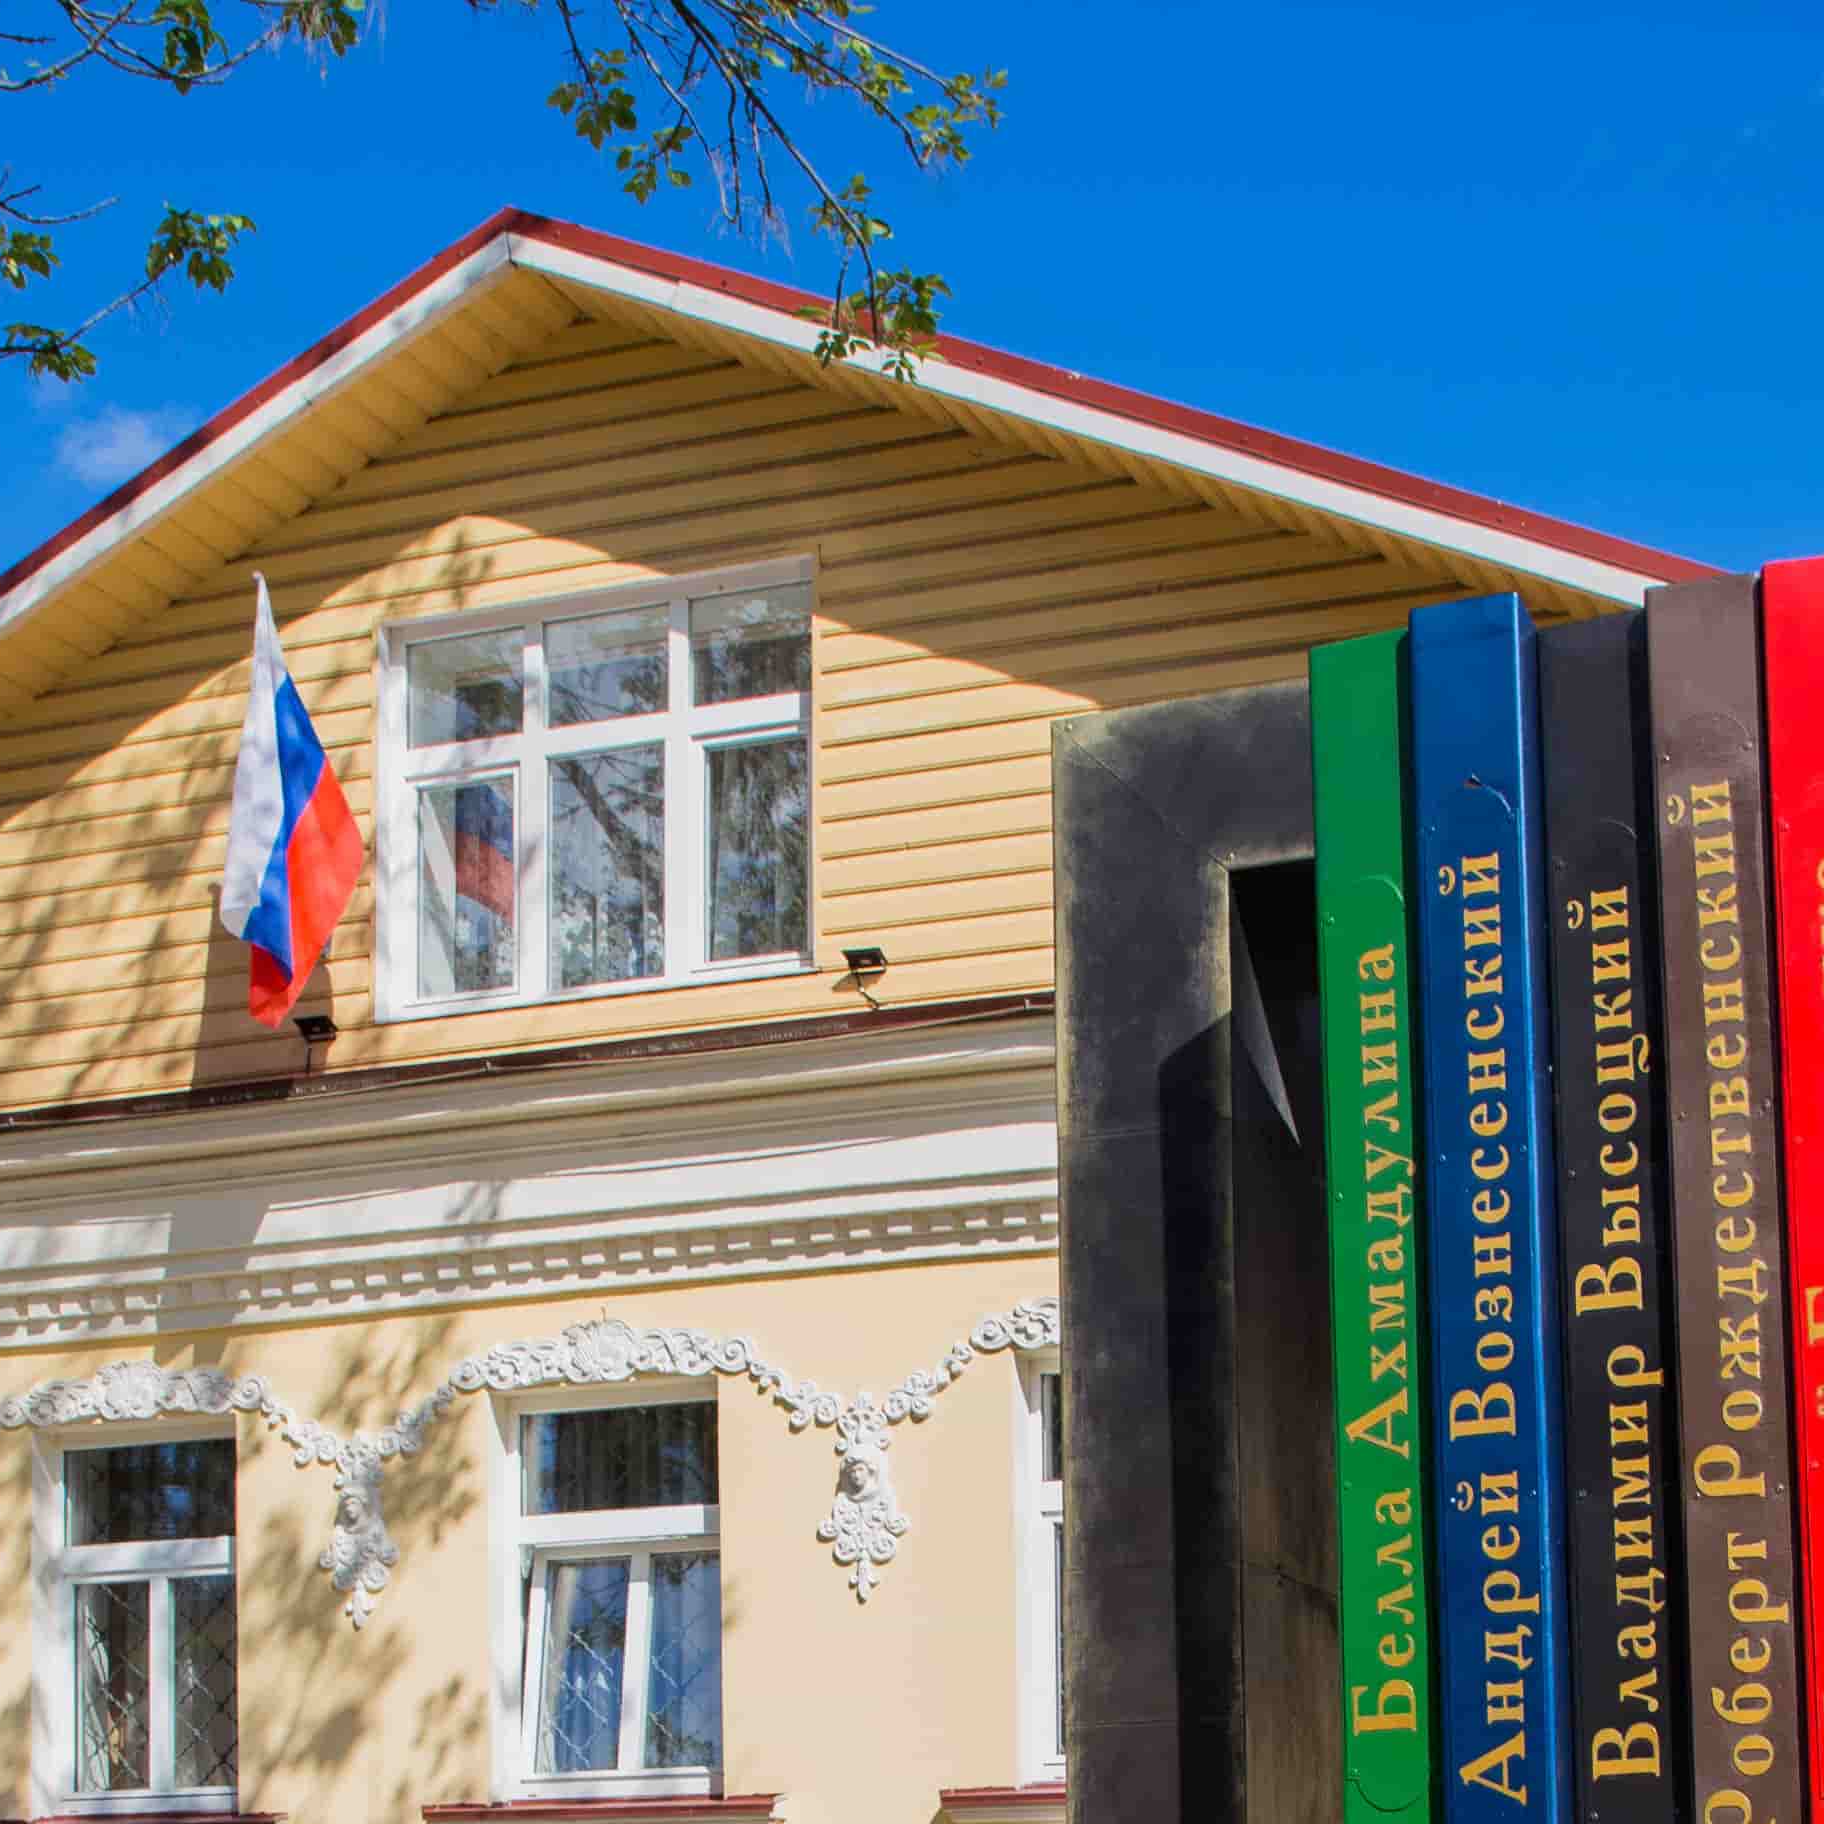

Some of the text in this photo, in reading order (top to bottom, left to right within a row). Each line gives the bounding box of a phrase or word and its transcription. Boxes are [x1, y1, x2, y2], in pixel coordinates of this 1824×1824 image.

[1345, 942, 1416, 1734] Белла Ахмадулина
[1438, 850, 1540, 1805] Андрей Вознесенский
[1566, 884, 1665, 1782] Владимир Высоцкий
[1666, 777, 1770, 1498] Рождественский
